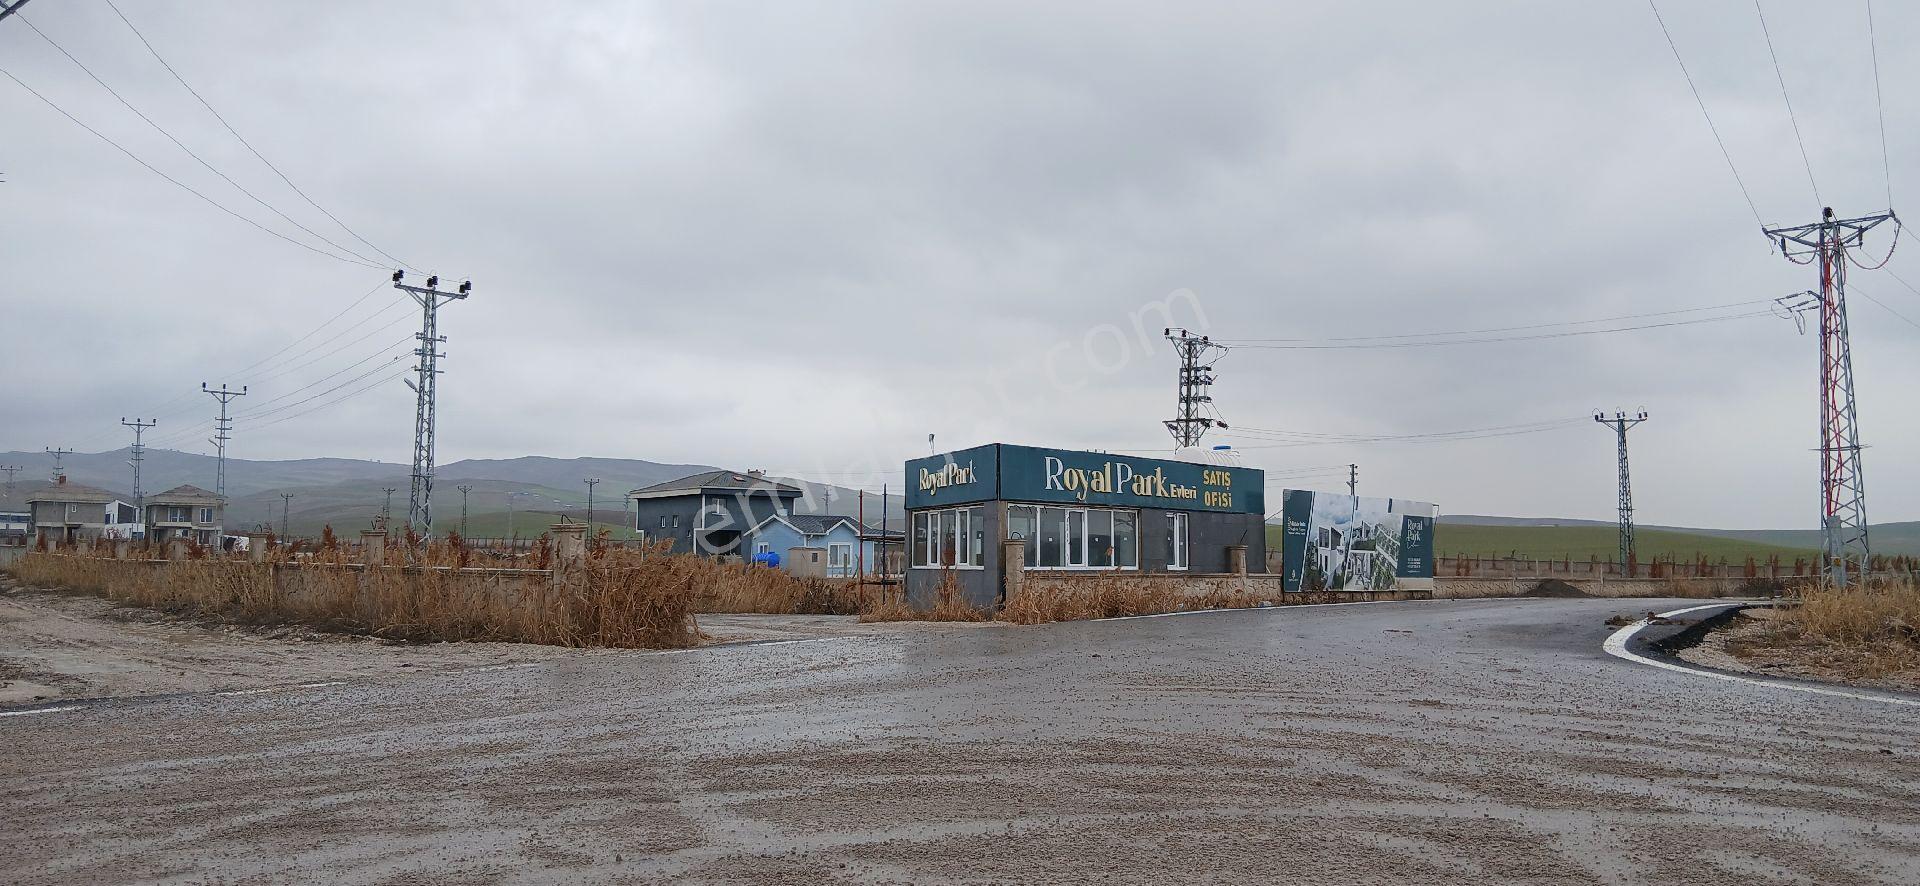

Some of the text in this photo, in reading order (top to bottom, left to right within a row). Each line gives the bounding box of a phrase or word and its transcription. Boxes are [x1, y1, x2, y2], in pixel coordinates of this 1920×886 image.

[919, 459, 977, 496] Royal Park
[1045, 456, 1197, 501] Royal Park Evleri
[1203, 469, 1231, 490] SATIŞ
